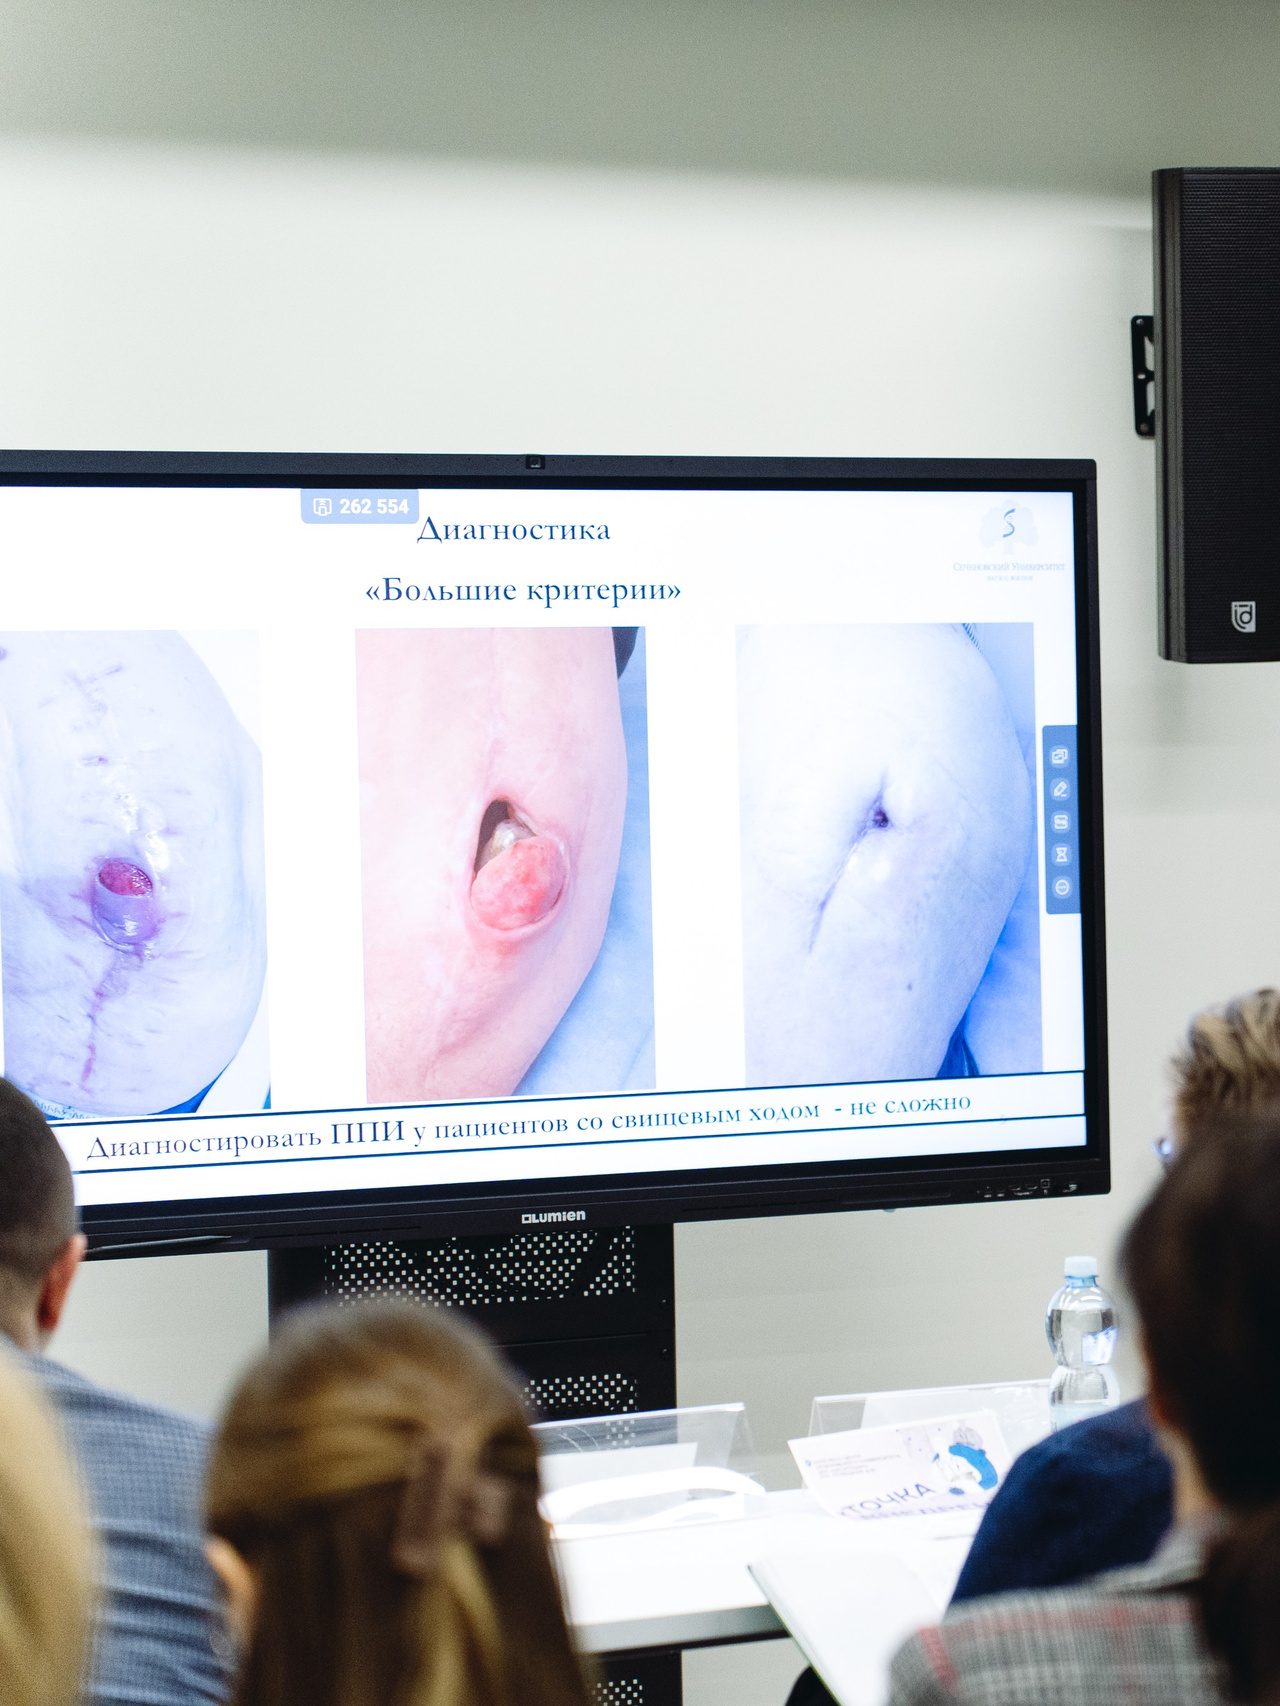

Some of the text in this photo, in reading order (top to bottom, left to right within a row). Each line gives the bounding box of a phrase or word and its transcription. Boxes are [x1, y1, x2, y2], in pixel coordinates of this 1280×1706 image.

[340, 498, 409, 515] 262 554
[417, 516, 611, 543] Диагностика
[365, 576, 681, 609] «Большие критерии»
[86, 1131, 321, 1160] Диагностировать
[331, 1120, 405, 1145] ППИ
[413, 1125, 429, 1146] у
[435, 1116, 568, 1141] пациентов
[577, 1114, 602, 1131] со
[611, 1107, 741, 1130] свищевым
[749, 1103, 820, 1124] ходом
[850, 1100, 877, 1116] не
[885, 1094, 971, 1114] сложно
